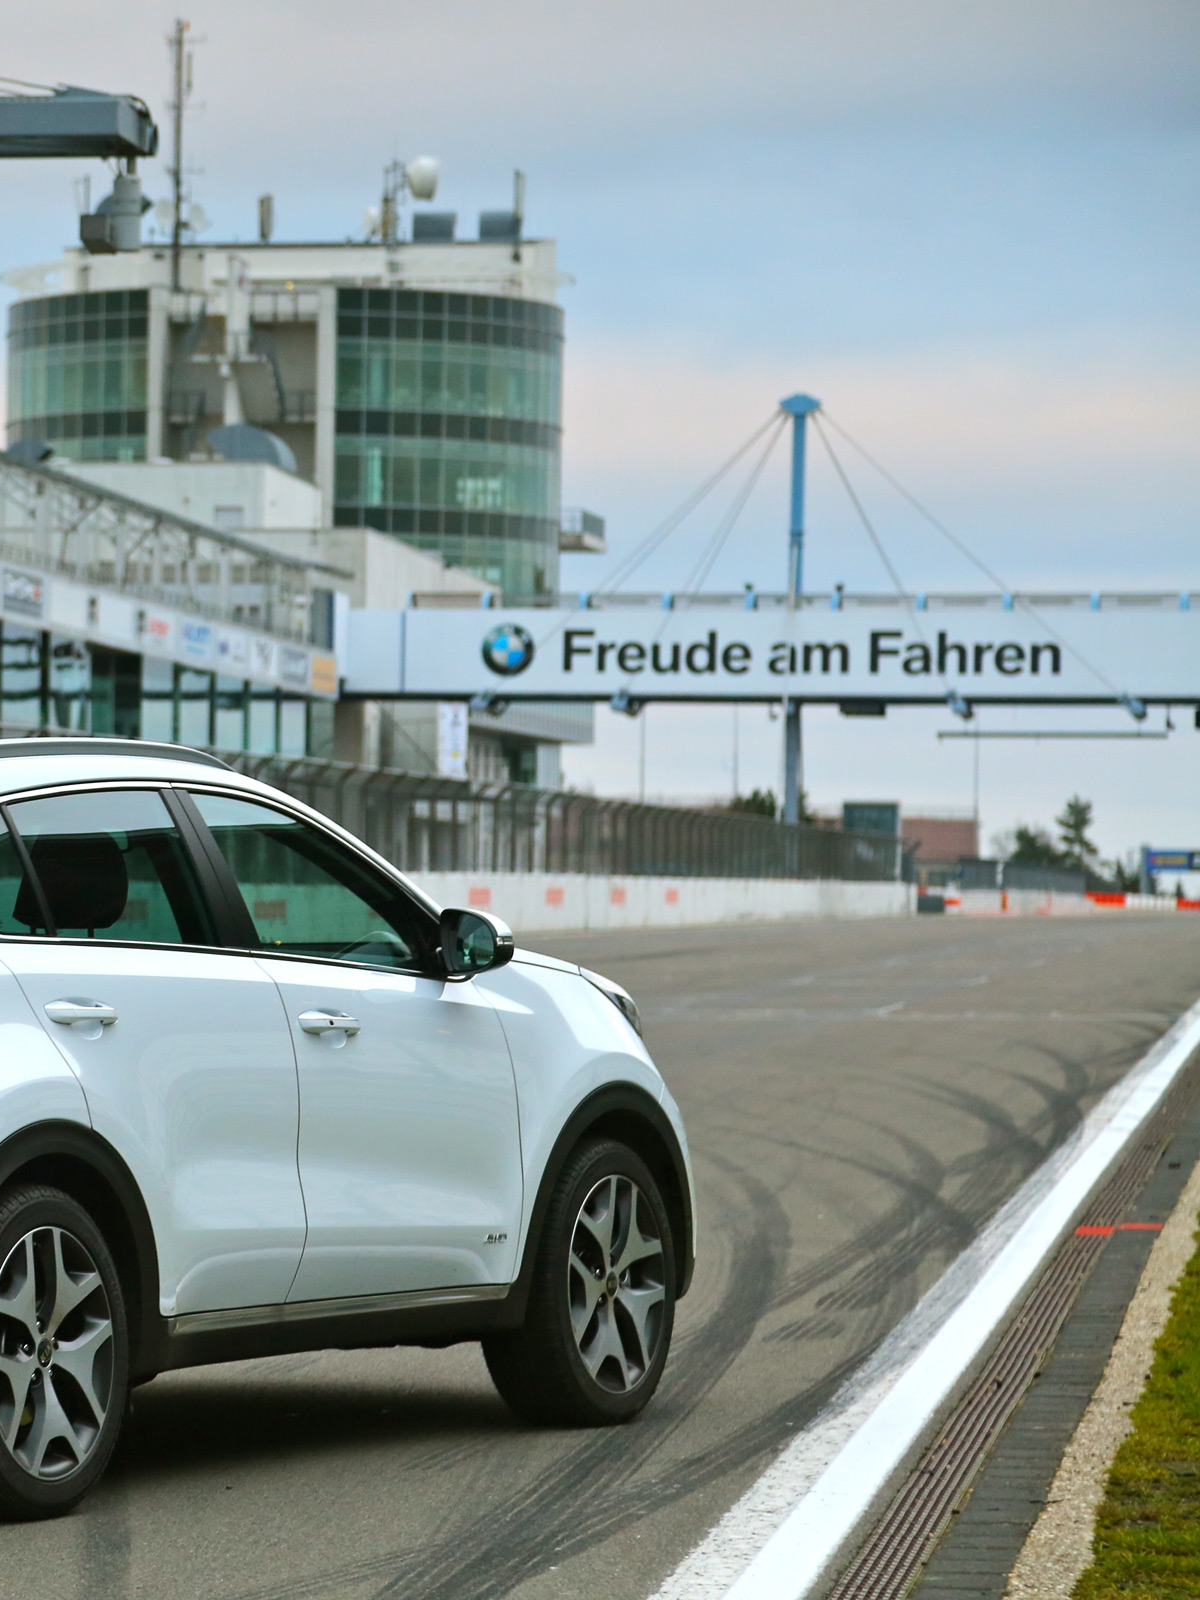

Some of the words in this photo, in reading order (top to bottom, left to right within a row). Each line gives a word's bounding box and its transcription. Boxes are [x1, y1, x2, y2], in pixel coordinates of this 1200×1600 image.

[562, 629, 753, 674] Freude
[768, 641, 849, 674] am
[869, 629, 1062, 675] Fahren
